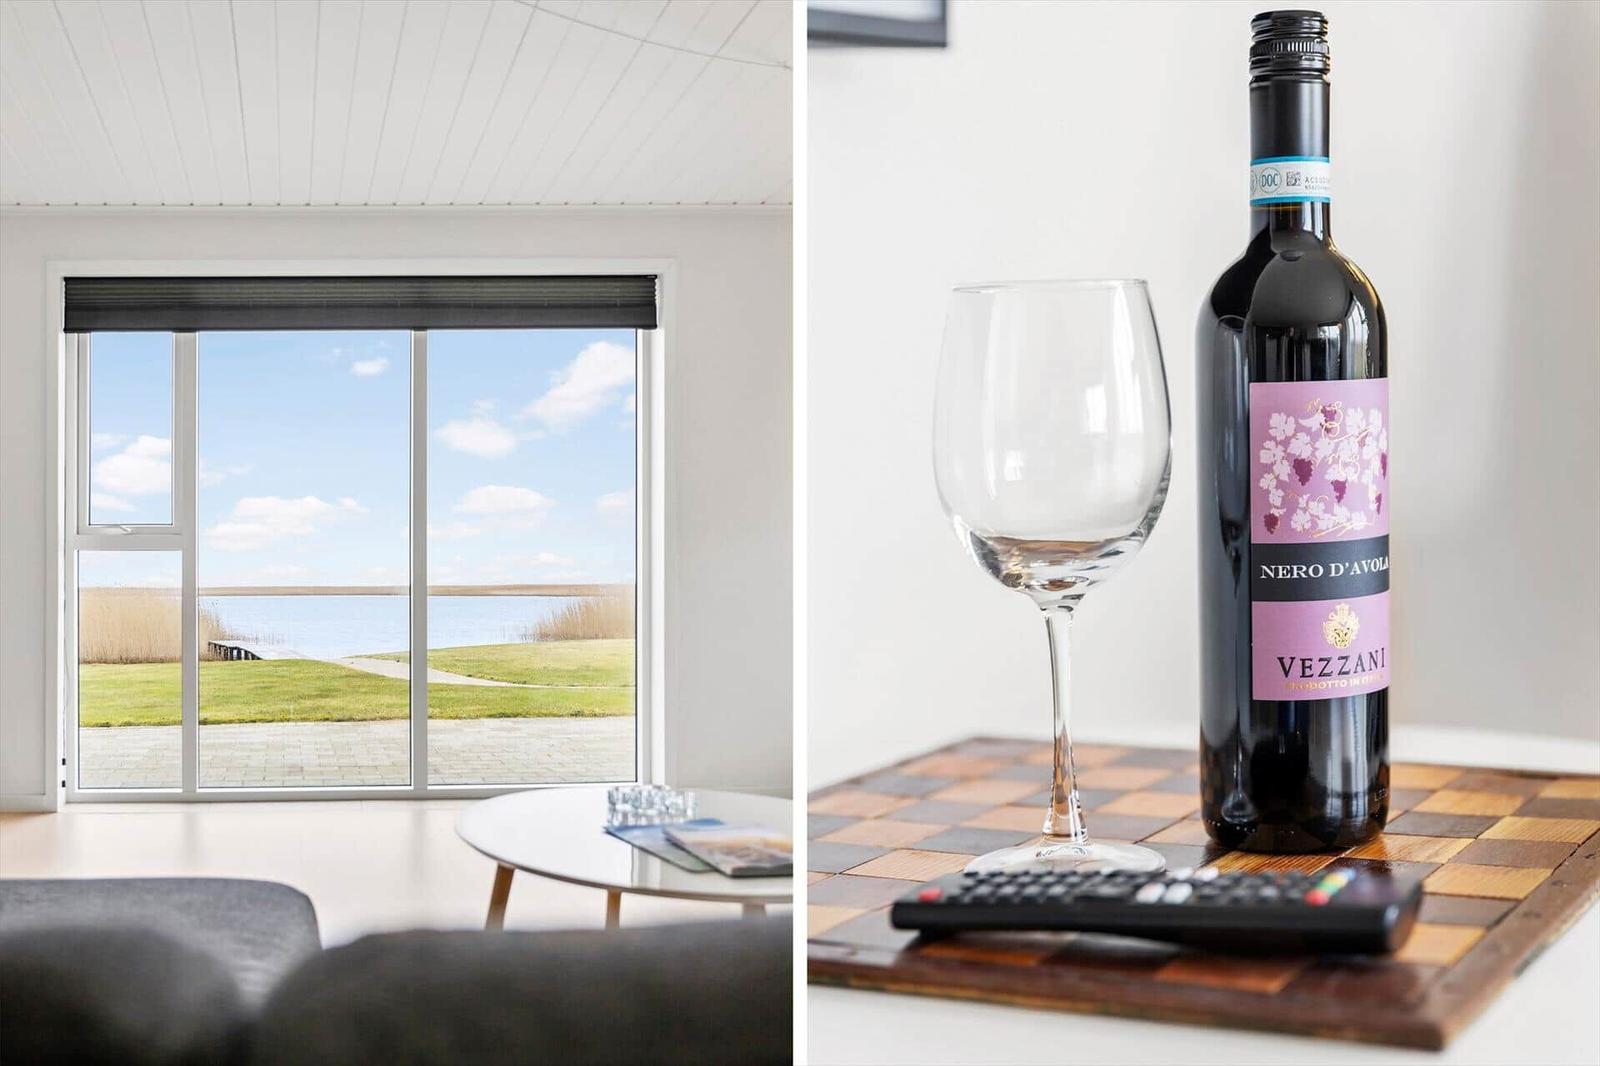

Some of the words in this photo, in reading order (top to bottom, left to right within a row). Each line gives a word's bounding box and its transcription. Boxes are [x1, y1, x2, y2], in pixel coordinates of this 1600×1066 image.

[1261, 173, 1278, 187] DOC
[1260, 564, 1324, 578] NERO
[1329, 556, 1389, 577] D'AVOLA
[1277, 647, 1385, 678] VEZZANI
